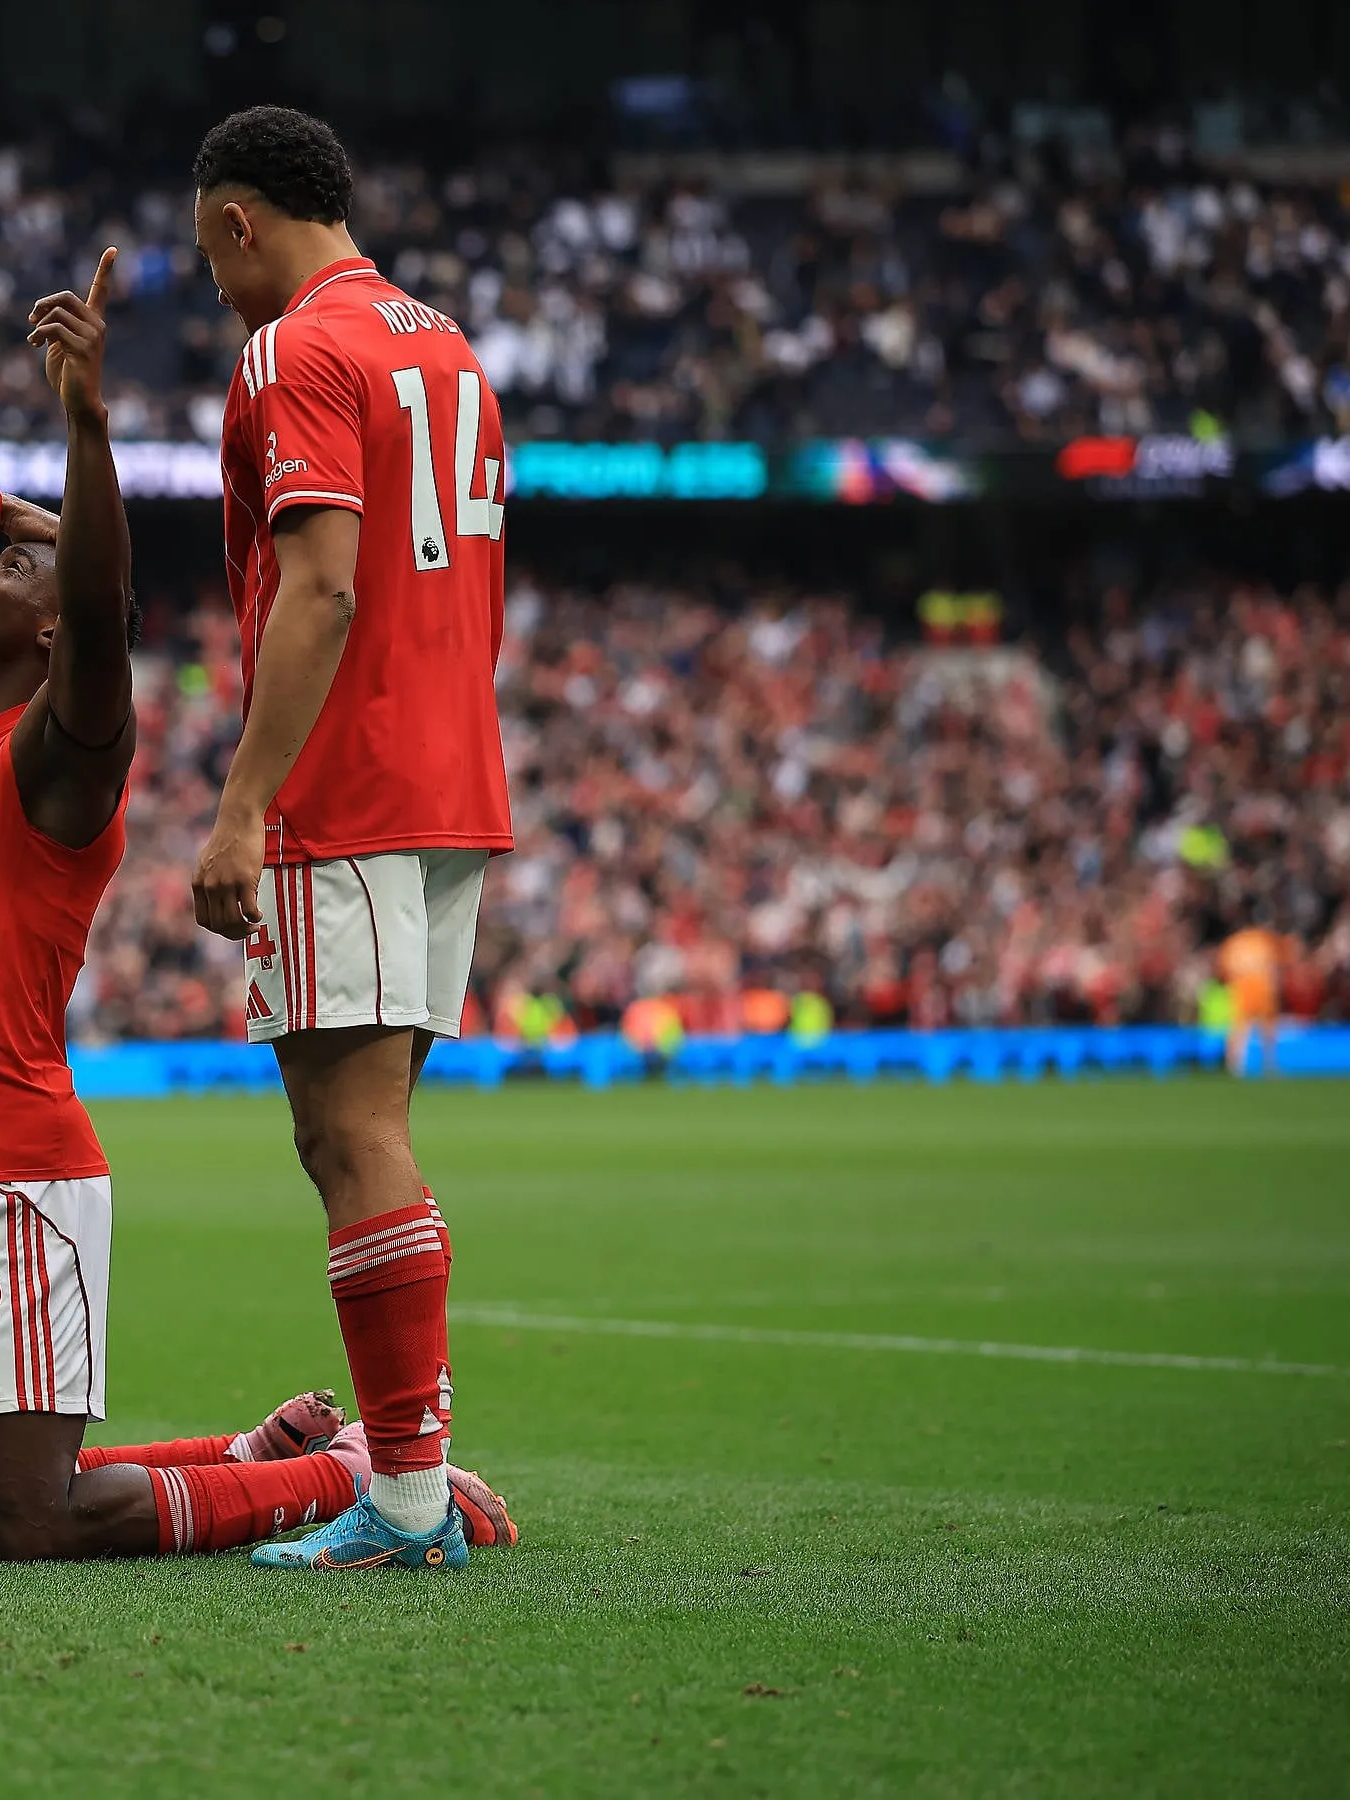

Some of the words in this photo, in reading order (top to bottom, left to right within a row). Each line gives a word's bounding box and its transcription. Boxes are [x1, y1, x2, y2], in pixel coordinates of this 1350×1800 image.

[265, 459, 308, 488] eagen
[390, 366, 505, 572] 14
[246, 923, 277, 971] 4
